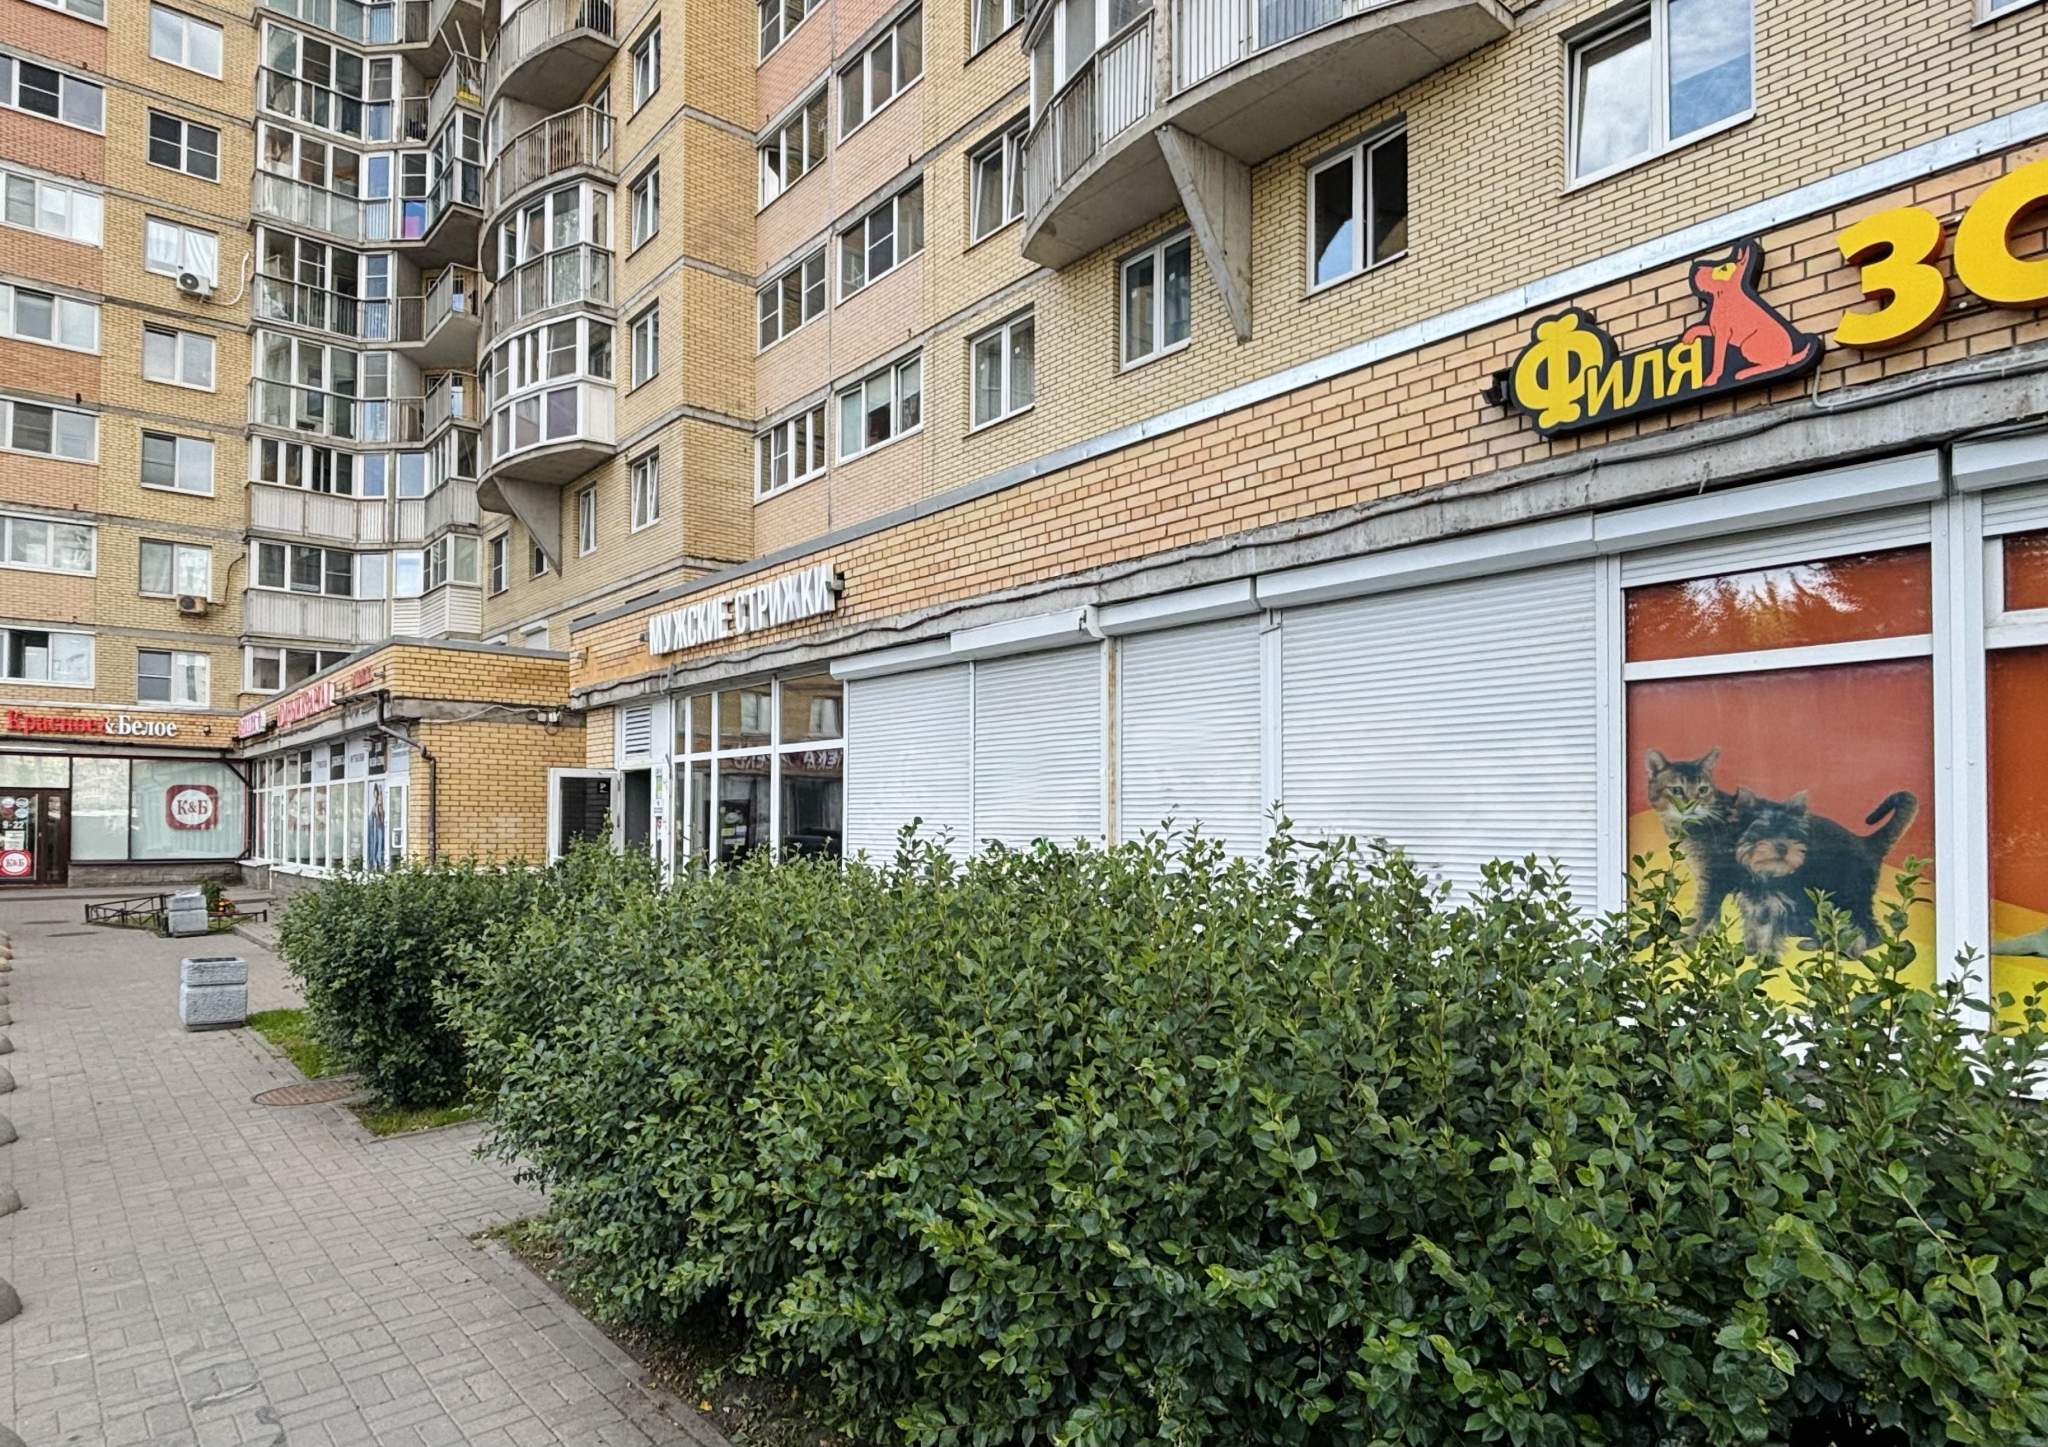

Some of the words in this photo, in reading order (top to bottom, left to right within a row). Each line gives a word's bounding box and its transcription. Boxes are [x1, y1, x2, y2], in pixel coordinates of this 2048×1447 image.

[649, 595, 730, 656] МУЖСКИЕ
[733, 563, 836, 635] СТРИЖКИ
[176, 799, 208, 815] К&Б
